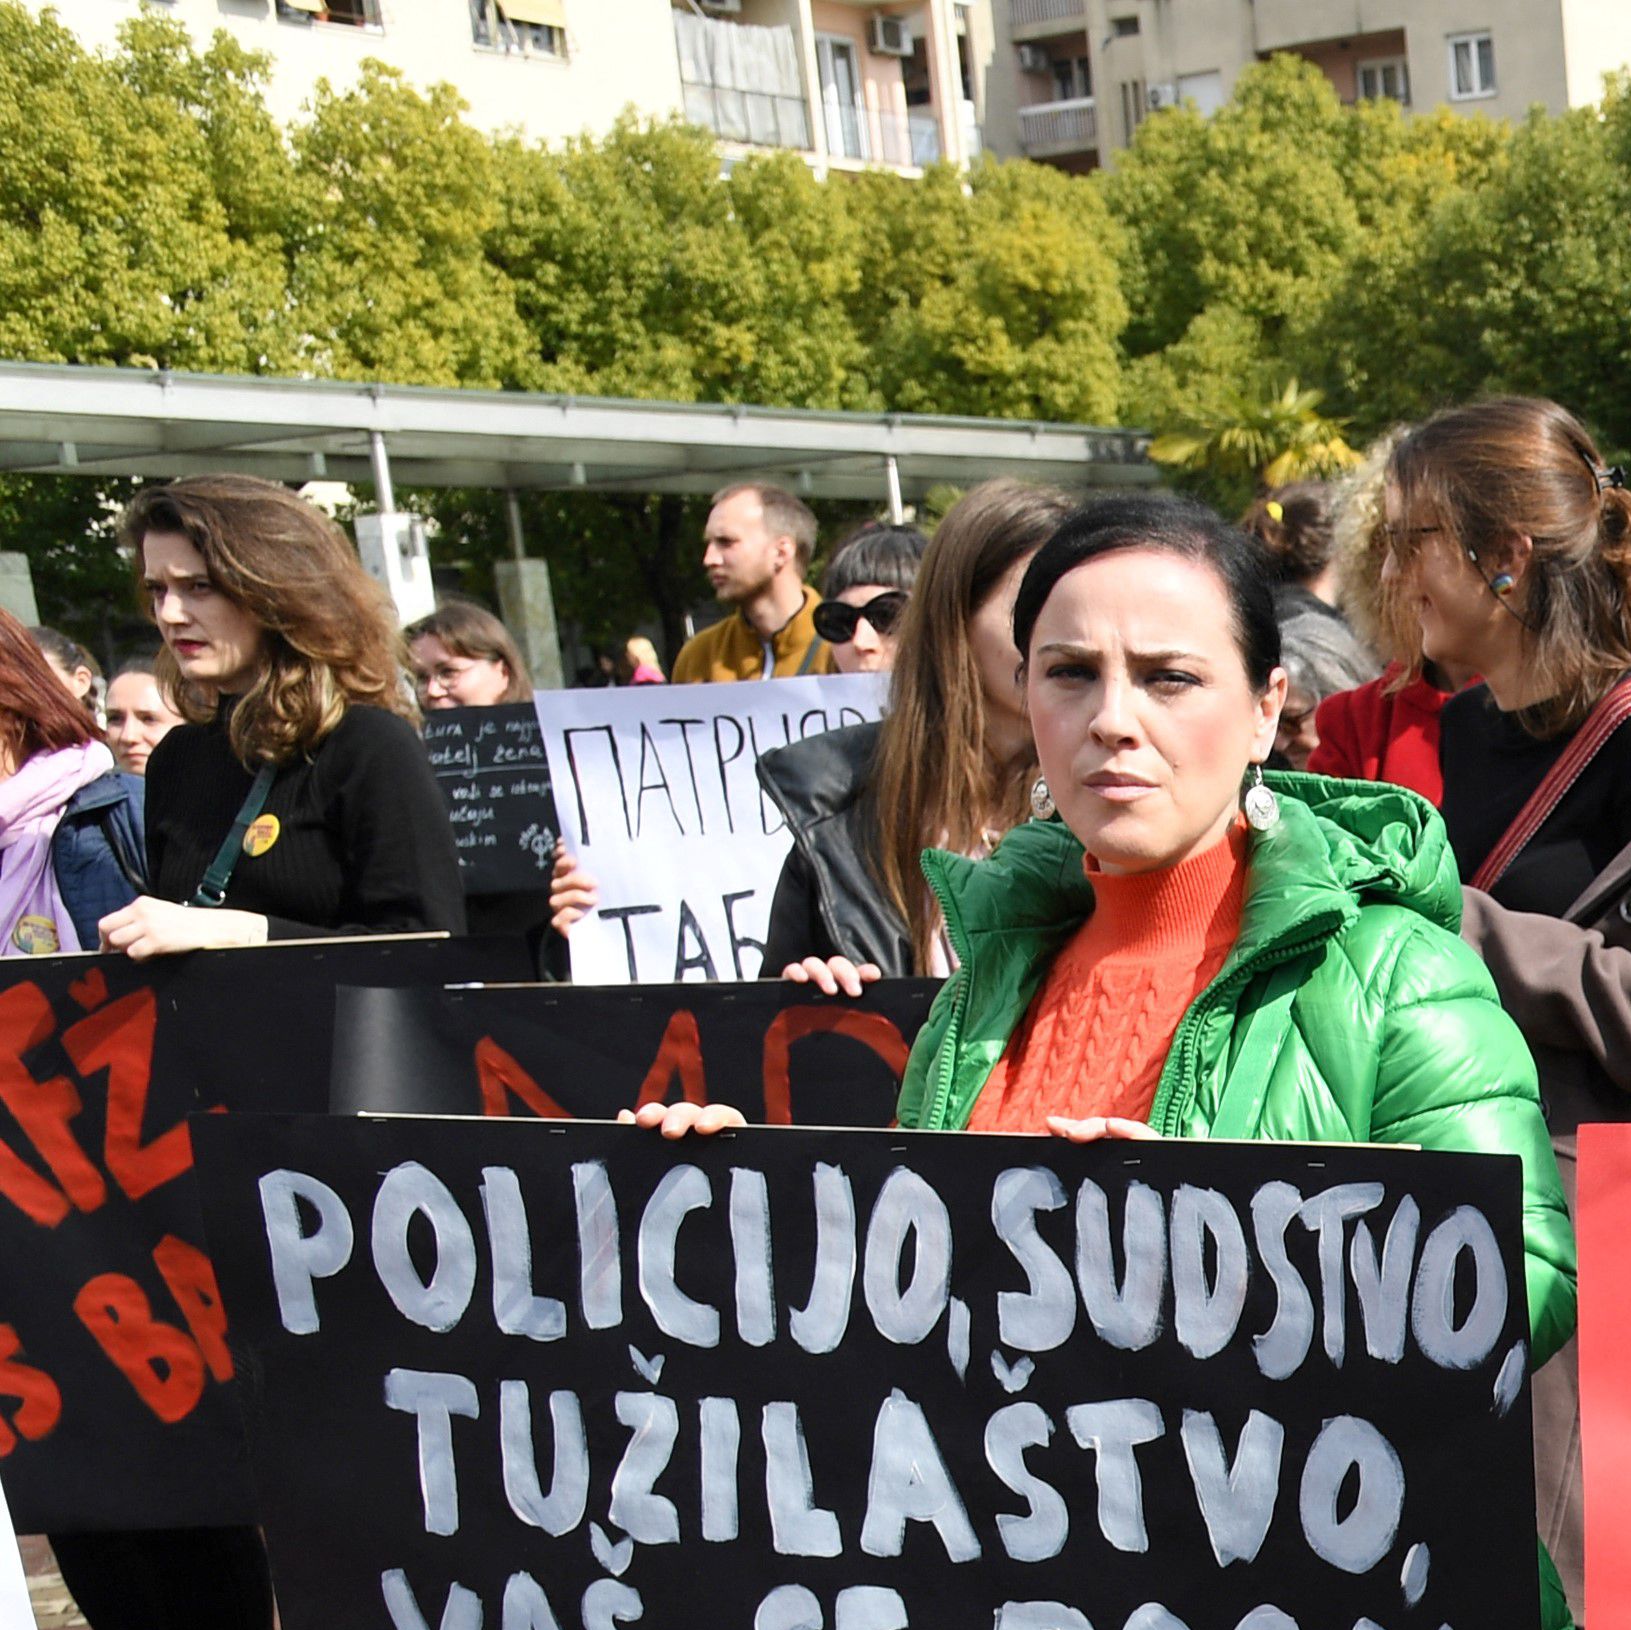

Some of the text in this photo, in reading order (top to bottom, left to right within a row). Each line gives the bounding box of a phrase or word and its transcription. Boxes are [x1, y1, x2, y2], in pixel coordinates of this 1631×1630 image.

[258, 1157, 1528, 1416] POLICIJO, SUDSTVO,
[383, 1344, 1430, 1606] TUŽILAŠTVO,
